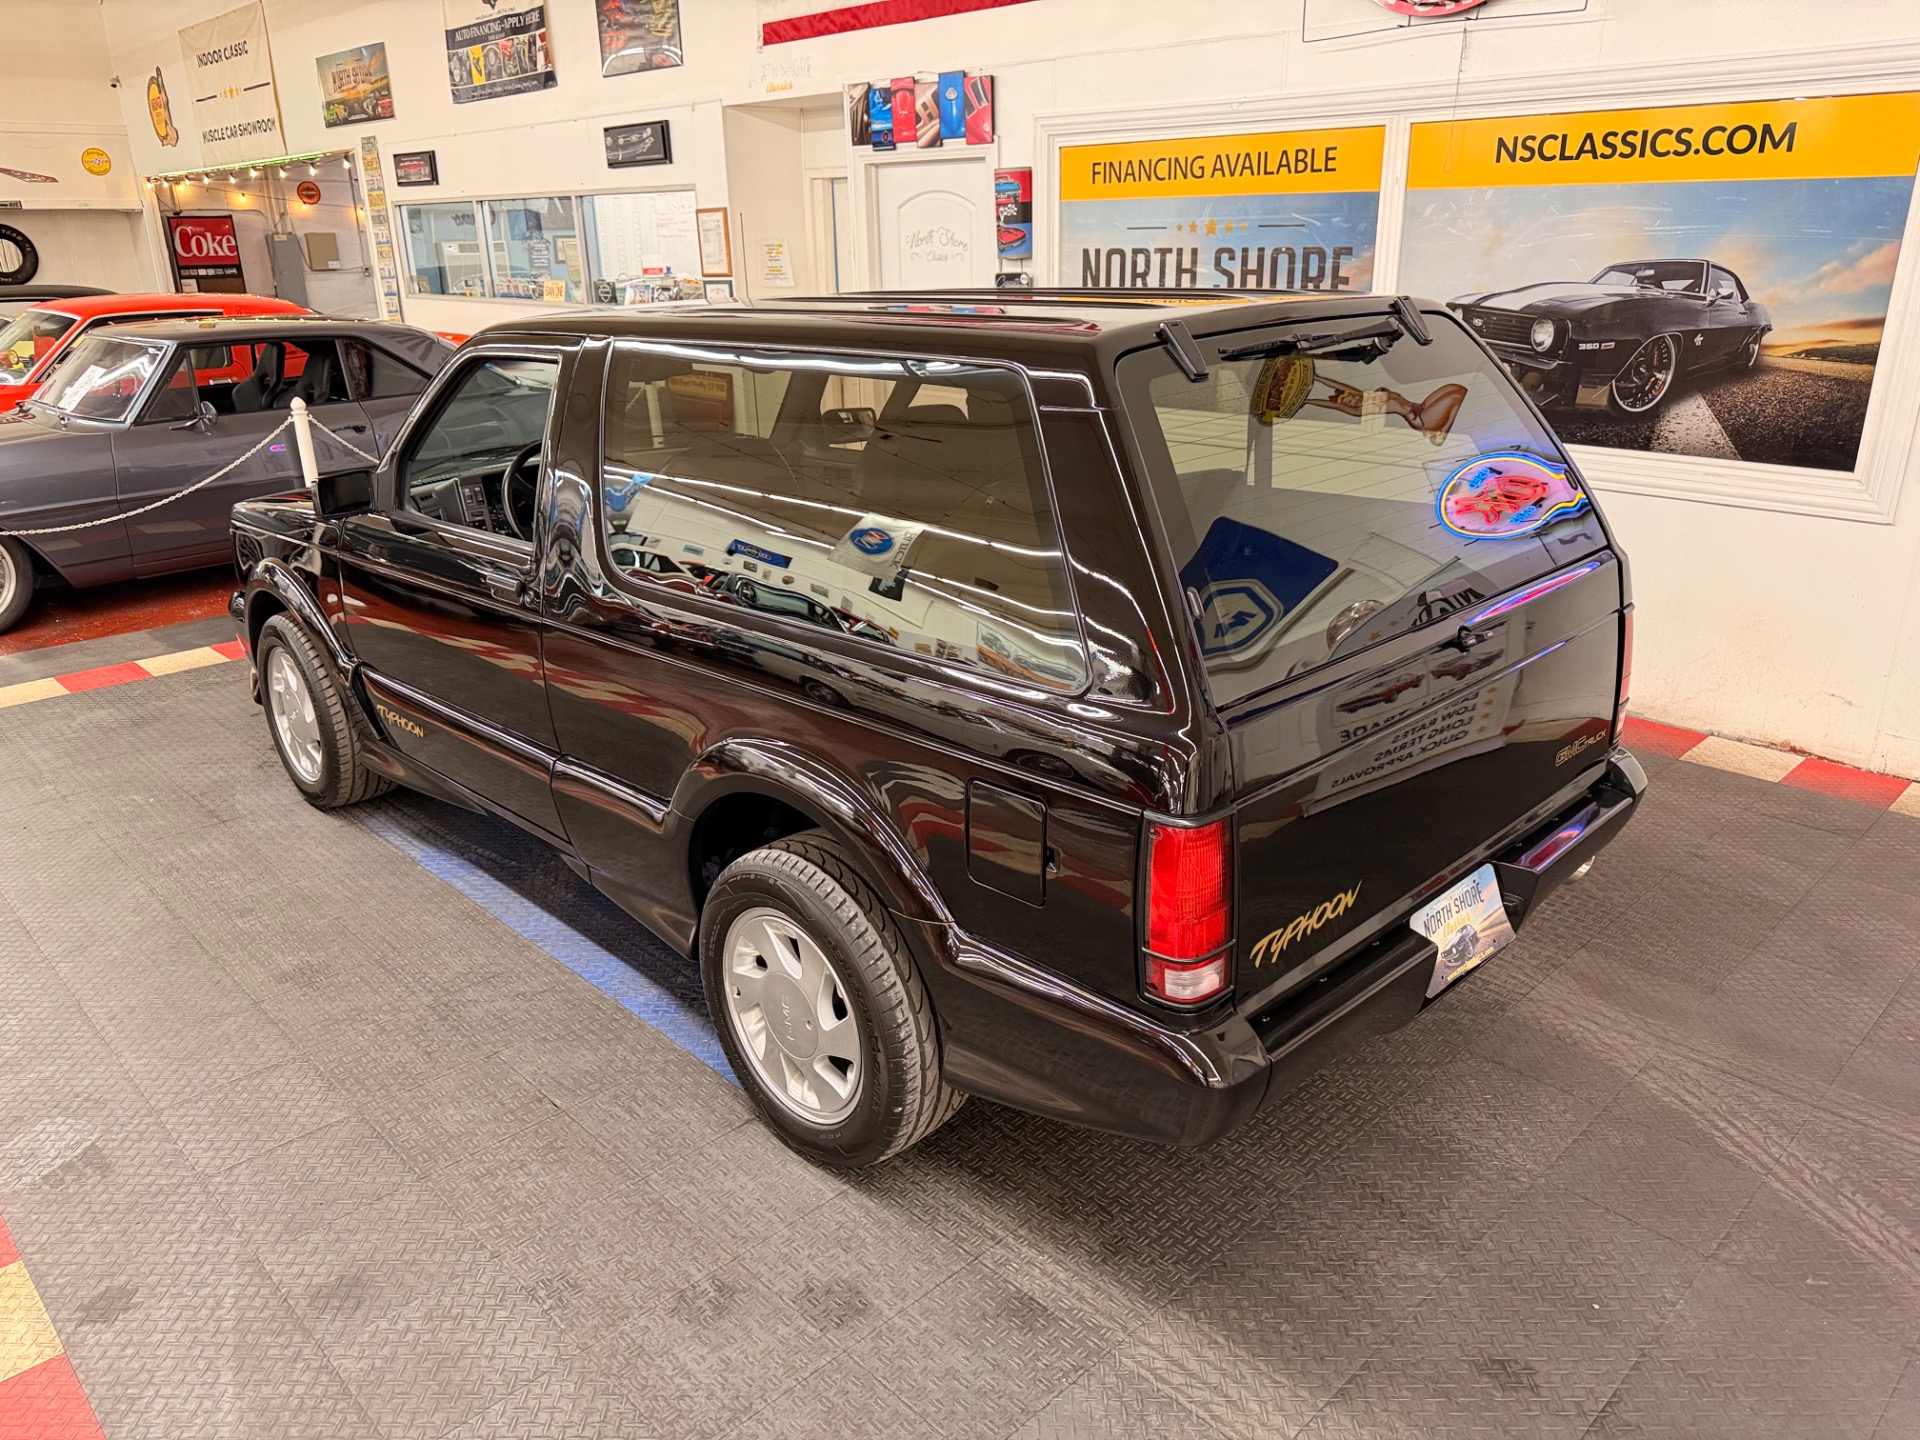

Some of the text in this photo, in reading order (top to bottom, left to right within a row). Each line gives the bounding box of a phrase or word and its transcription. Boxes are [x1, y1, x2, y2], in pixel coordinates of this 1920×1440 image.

[525, 10, 540, 25] HERE
[196, 40, 249, 68] INDOOR CLASSIC
[202, 117, 277, 144] MUSCLE CAR SHOWROOM
[1494, 121, 1797, 165] NSCLASSICS.COM
[1091, 146, 1338, 185] FINANCING AVAILABLE
[174, 226, 237, 258] Coke
[904, 226, 969, 251] North Shore
[1081, 246, 1354, 290] NORTH SHORE
[1578, 342, 1600, 351] 350
[376, 704, 424, 738] TYPHOON
[1555, 728, 1607, 767] GMC TRUCK
[1250, 878, 1363, 969] TYPHOON
[1423, 881, 1485, 939] NORTH SHORE
[1443, 912, 1472, 938] Classics
